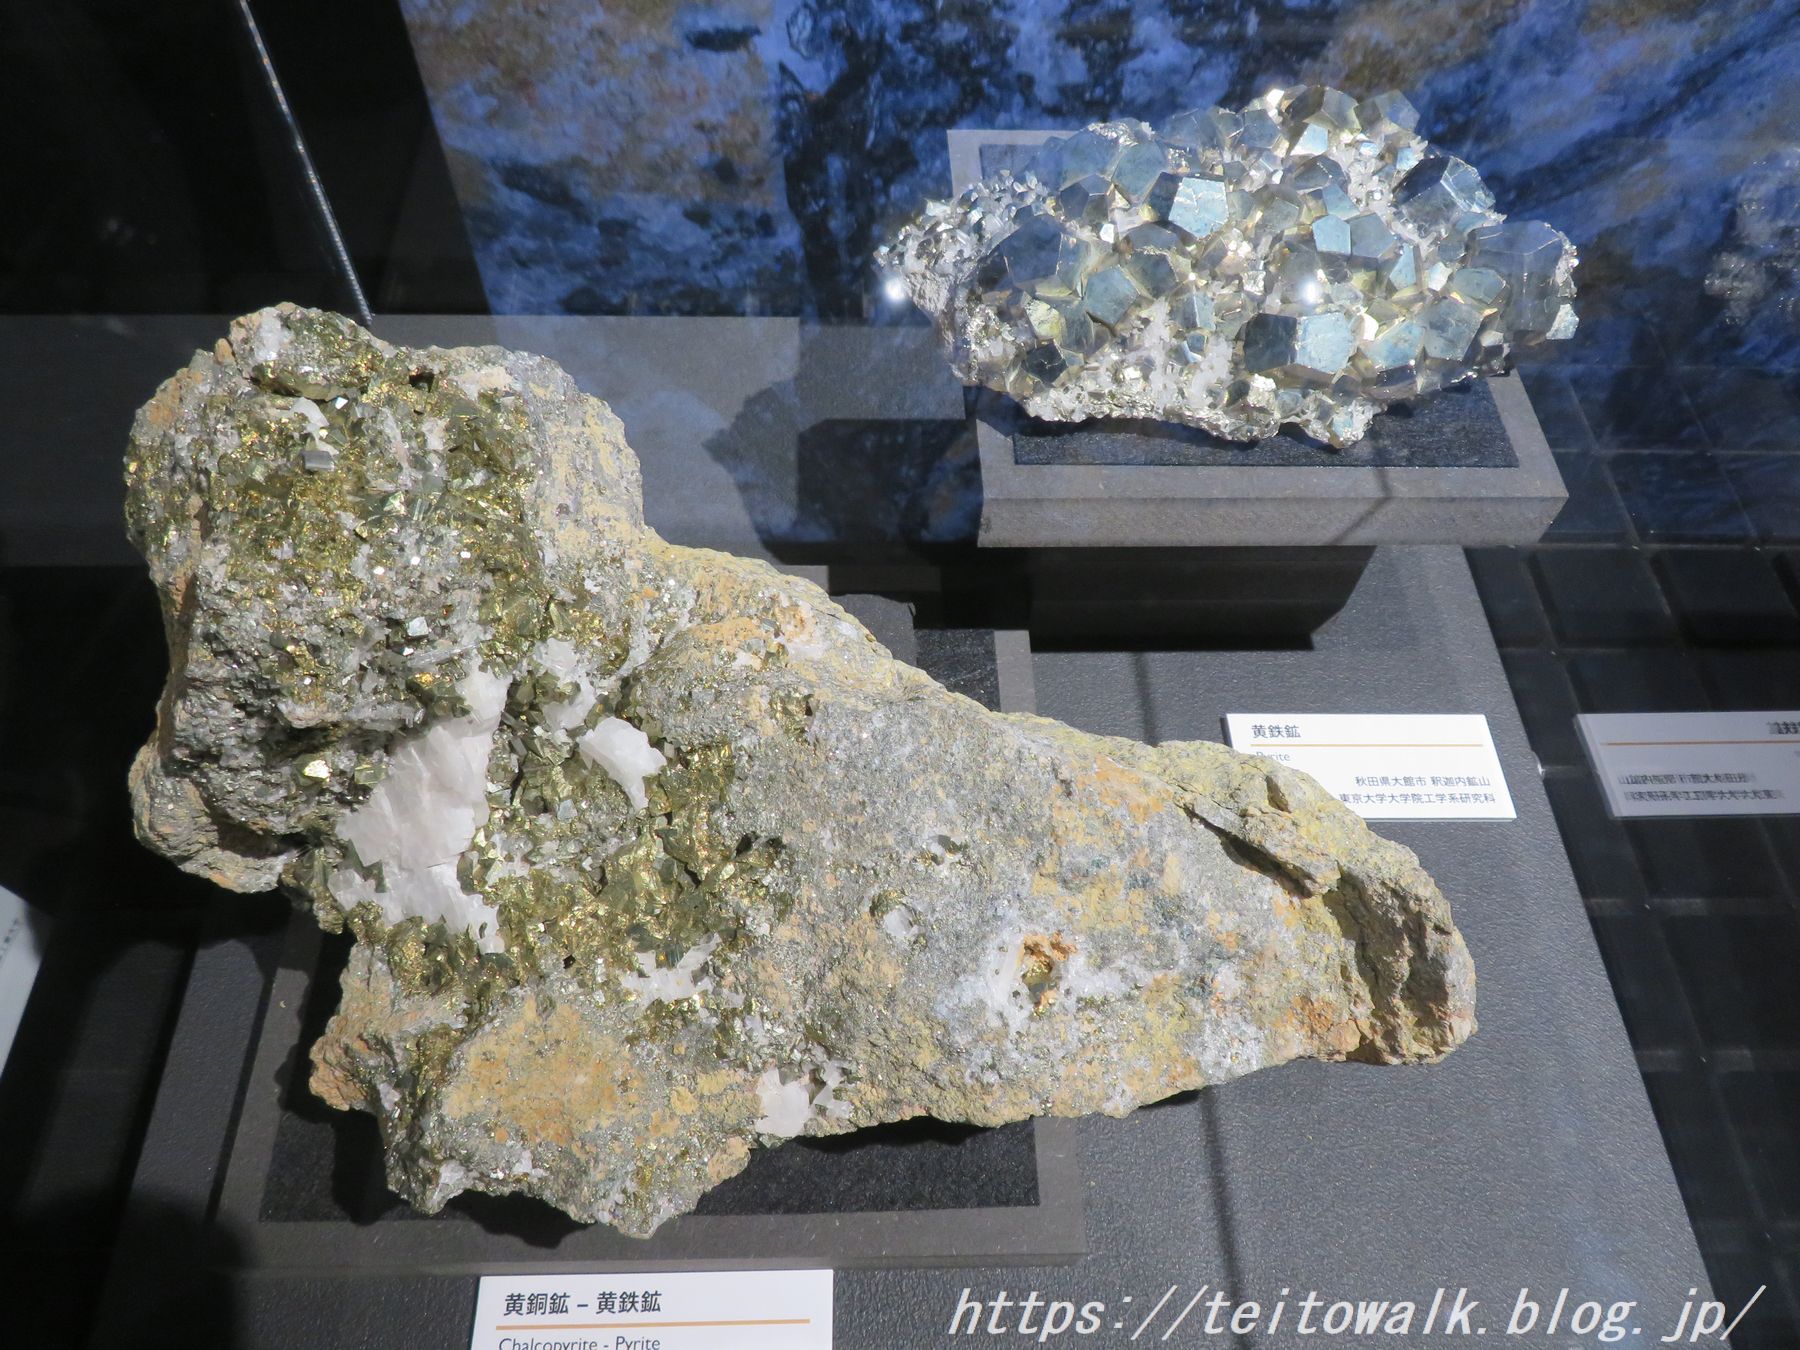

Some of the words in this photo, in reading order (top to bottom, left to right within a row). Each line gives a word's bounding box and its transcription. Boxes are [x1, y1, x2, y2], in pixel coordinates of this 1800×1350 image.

[1251, 724, 1301, 738] 黄鉄鉱
[1355, 776, 1427, 787] 秋田県大館市
[1430, 776, 1490, 787] 釈迦内鉱山
[1340, 793, 1495, 804] 東京大学大学院工学系研究科
[503, 1292, 571, 1317] 黄銅鉱
[596, 1290, 663, 1315] 黄鉄鉱
[616, 1336, 661, 1350] Pyrite
